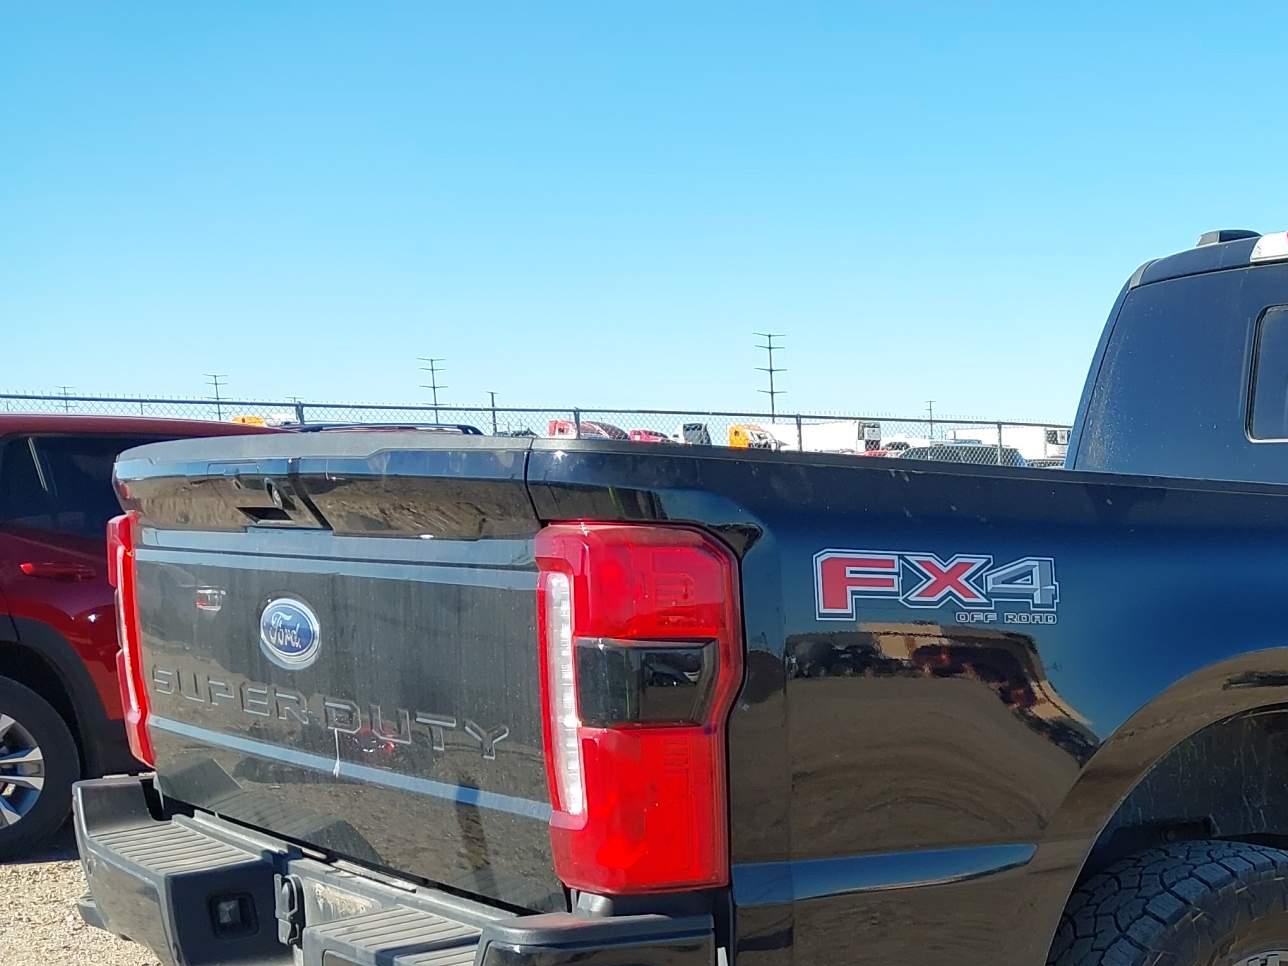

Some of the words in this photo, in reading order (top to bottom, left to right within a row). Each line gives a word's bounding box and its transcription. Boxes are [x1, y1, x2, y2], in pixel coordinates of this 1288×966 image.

[813, 548, 1059, 621] FX4
[269, 610, 302, 649] Ford
[955, 611, 998, 624] OFF
[1003, 612, 1058, 625] ROAD
[152, 667, 310, 725] SUPER
[323, 697, 510, 760] DUTY
